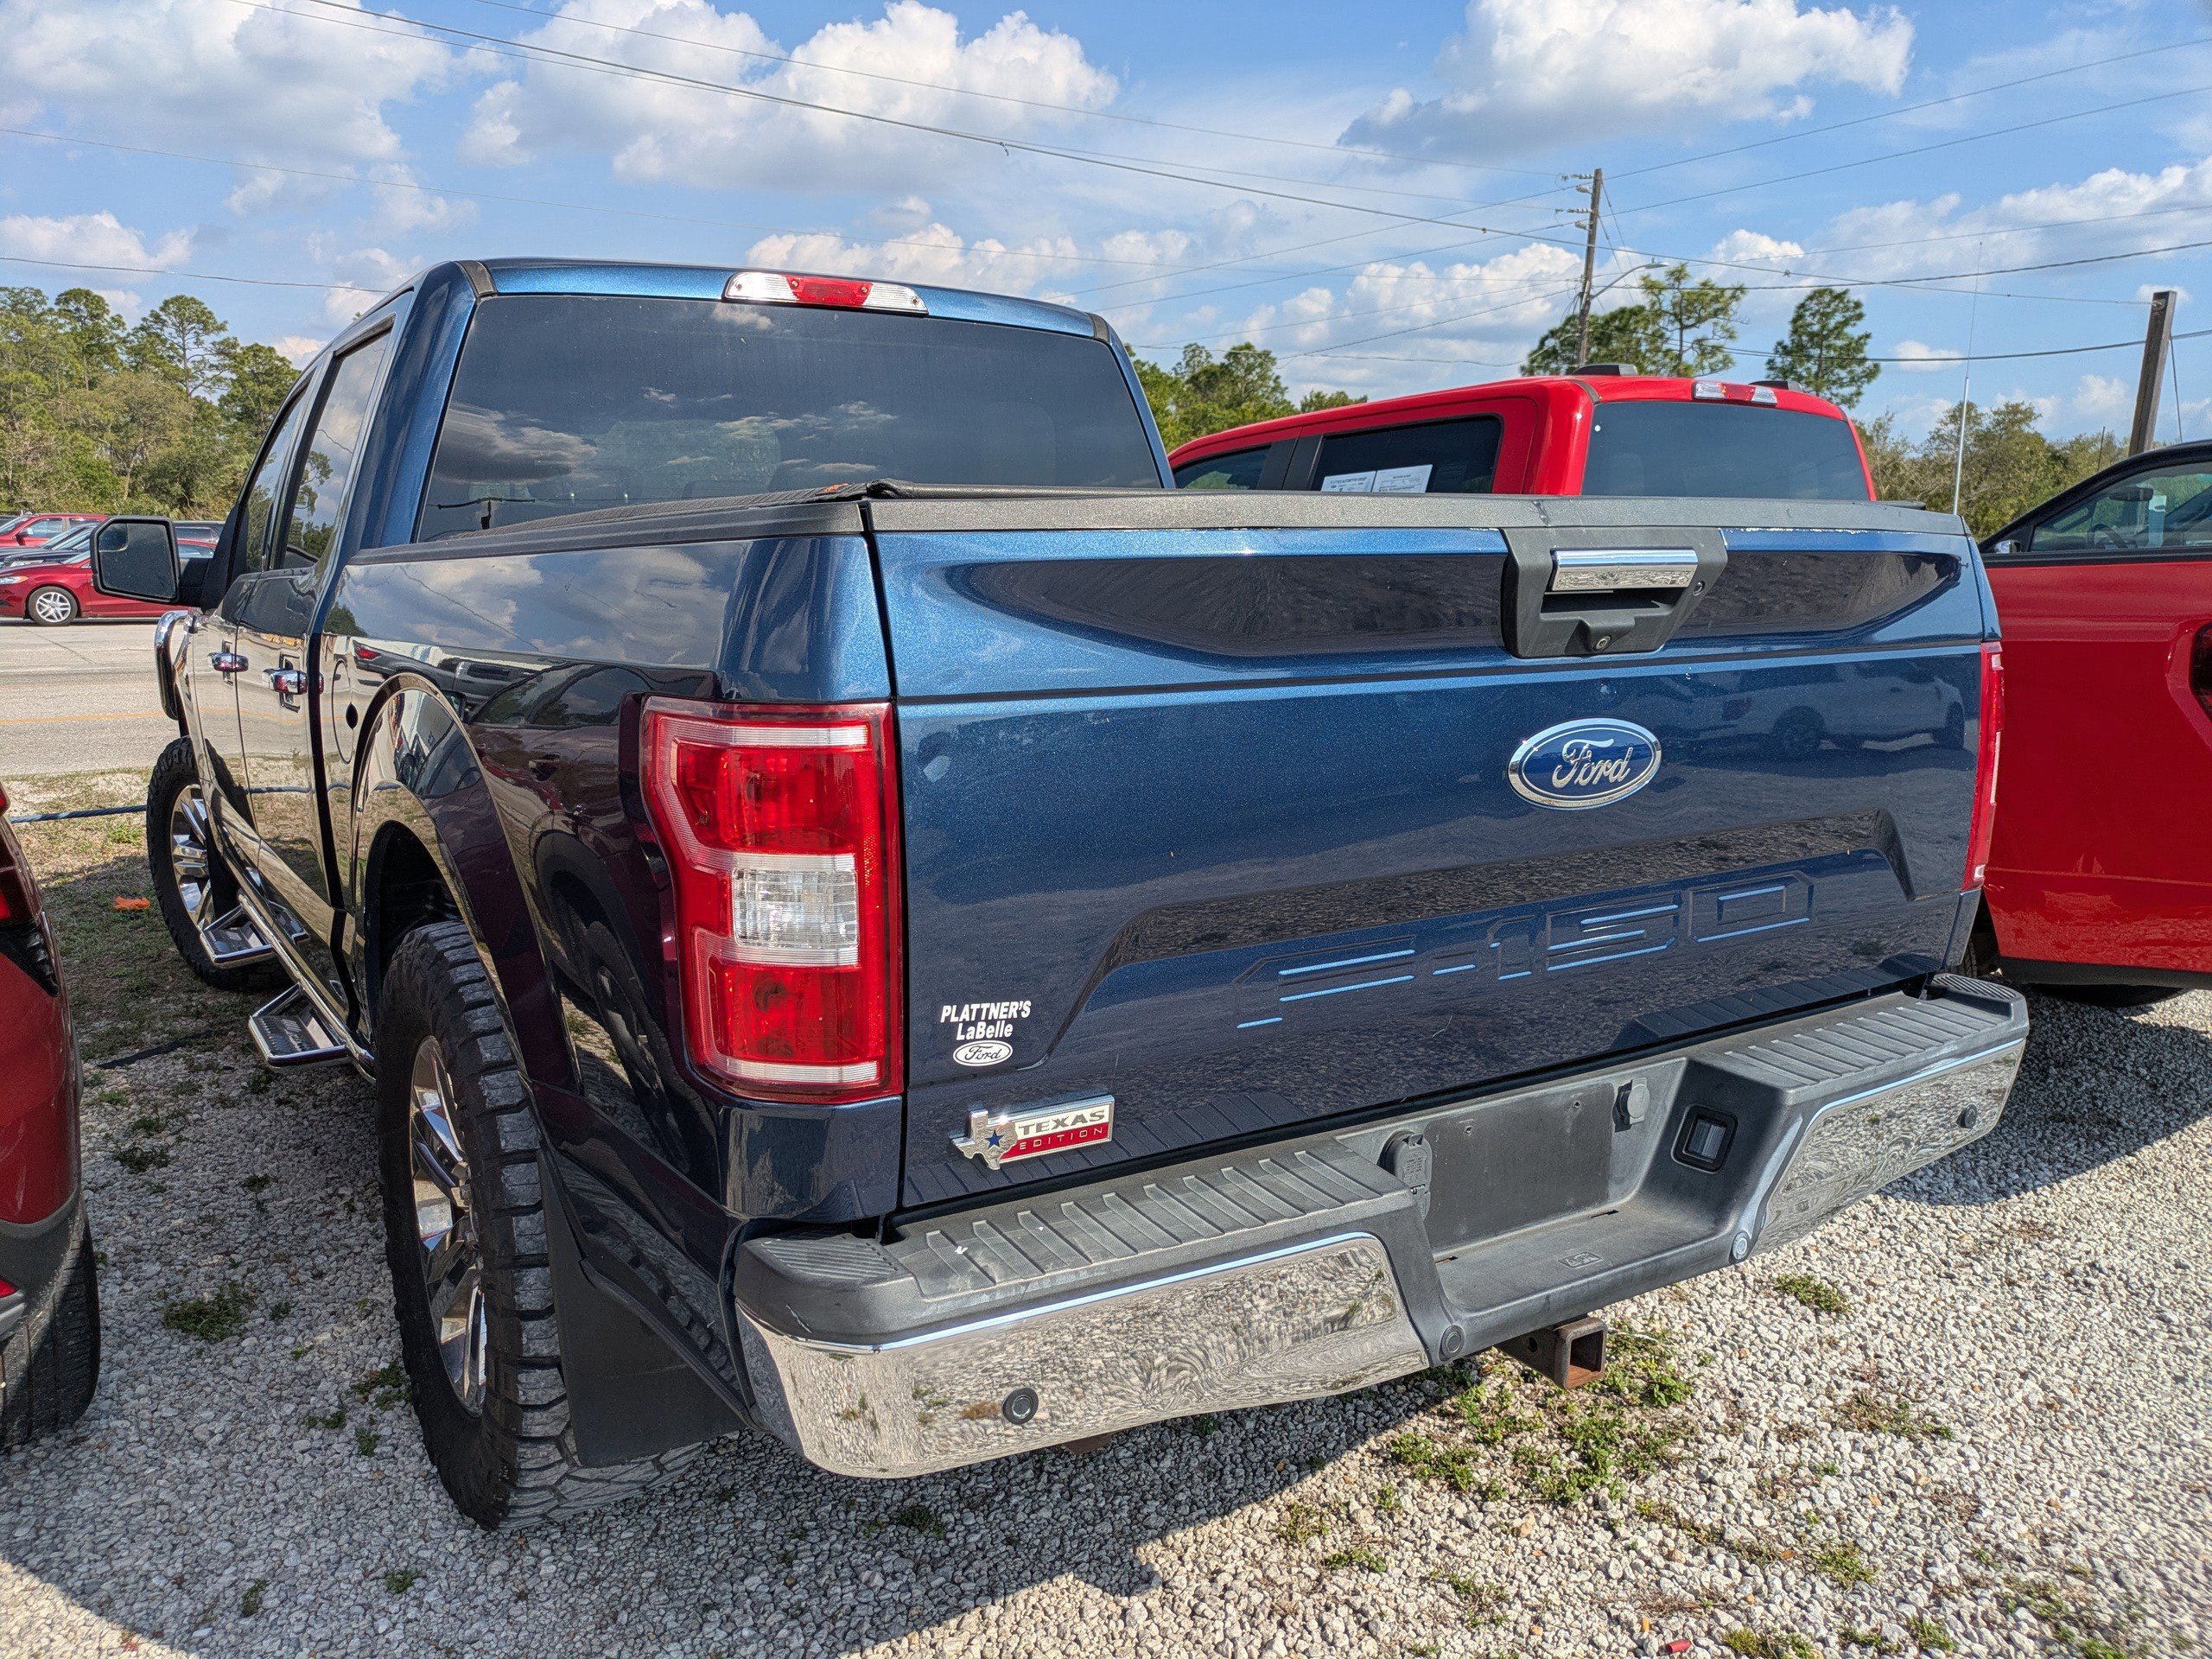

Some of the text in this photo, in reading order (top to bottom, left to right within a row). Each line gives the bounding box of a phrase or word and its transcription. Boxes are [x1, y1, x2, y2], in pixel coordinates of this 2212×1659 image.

[1552, 738, 1633, 788] Ford
[1234, 870, 1813, 1029] F-150
[940, 1001, 1032, 1023] PLATTNER'S
[956, 1020, 1014, 1040] LaBelle
[964, 1046, 1001, 1061] Ford
[1018, 1109, 1105, 1136] TEXAS
[1019, 1127, 1103, 1151] EDITION
